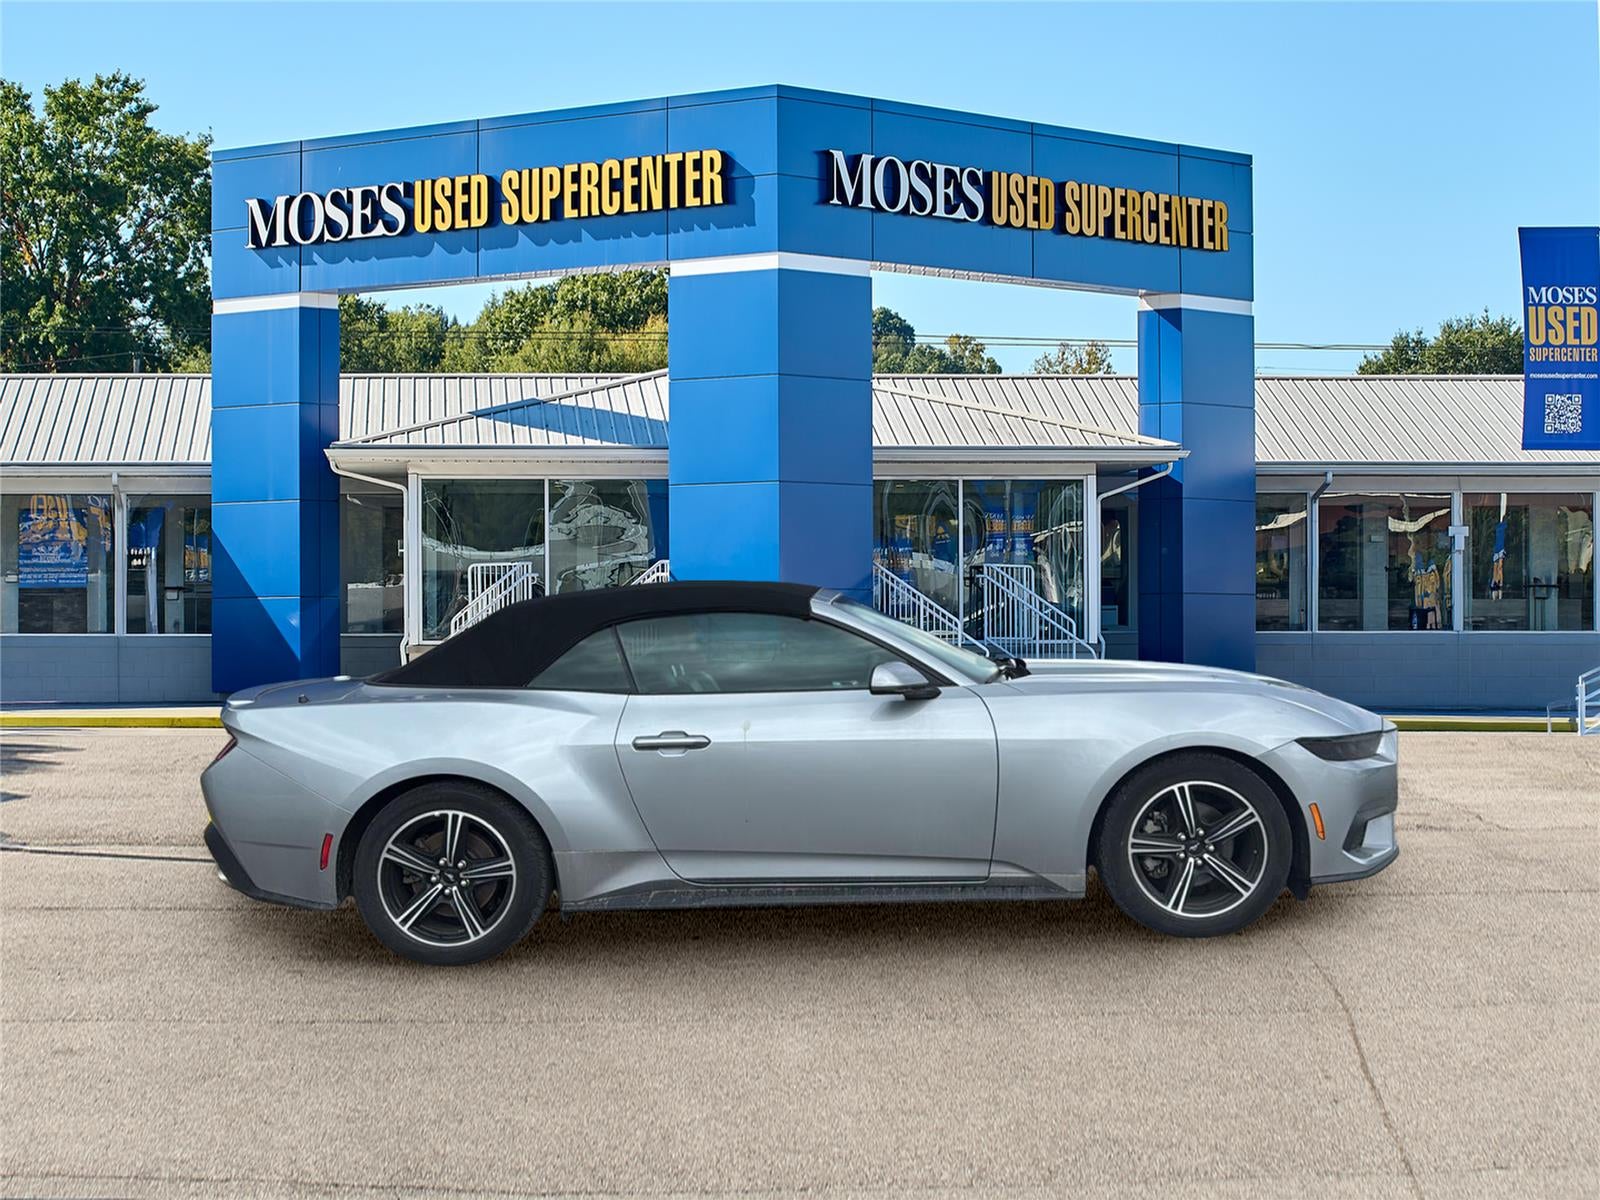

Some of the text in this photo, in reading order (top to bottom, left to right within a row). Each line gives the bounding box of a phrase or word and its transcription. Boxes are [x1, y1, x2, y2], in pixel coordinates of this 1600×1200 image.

[244, 149, 724, 249] MOSES USED SUPERCENTER
[829, 148, 1229, 252] MOSES USED SUPERCENTER
[1527, 286, 1597, 305] MOSES
[1528, 306, 1598, 346] USED
[1529, 347, 1598, 362] SUPERCENTER
